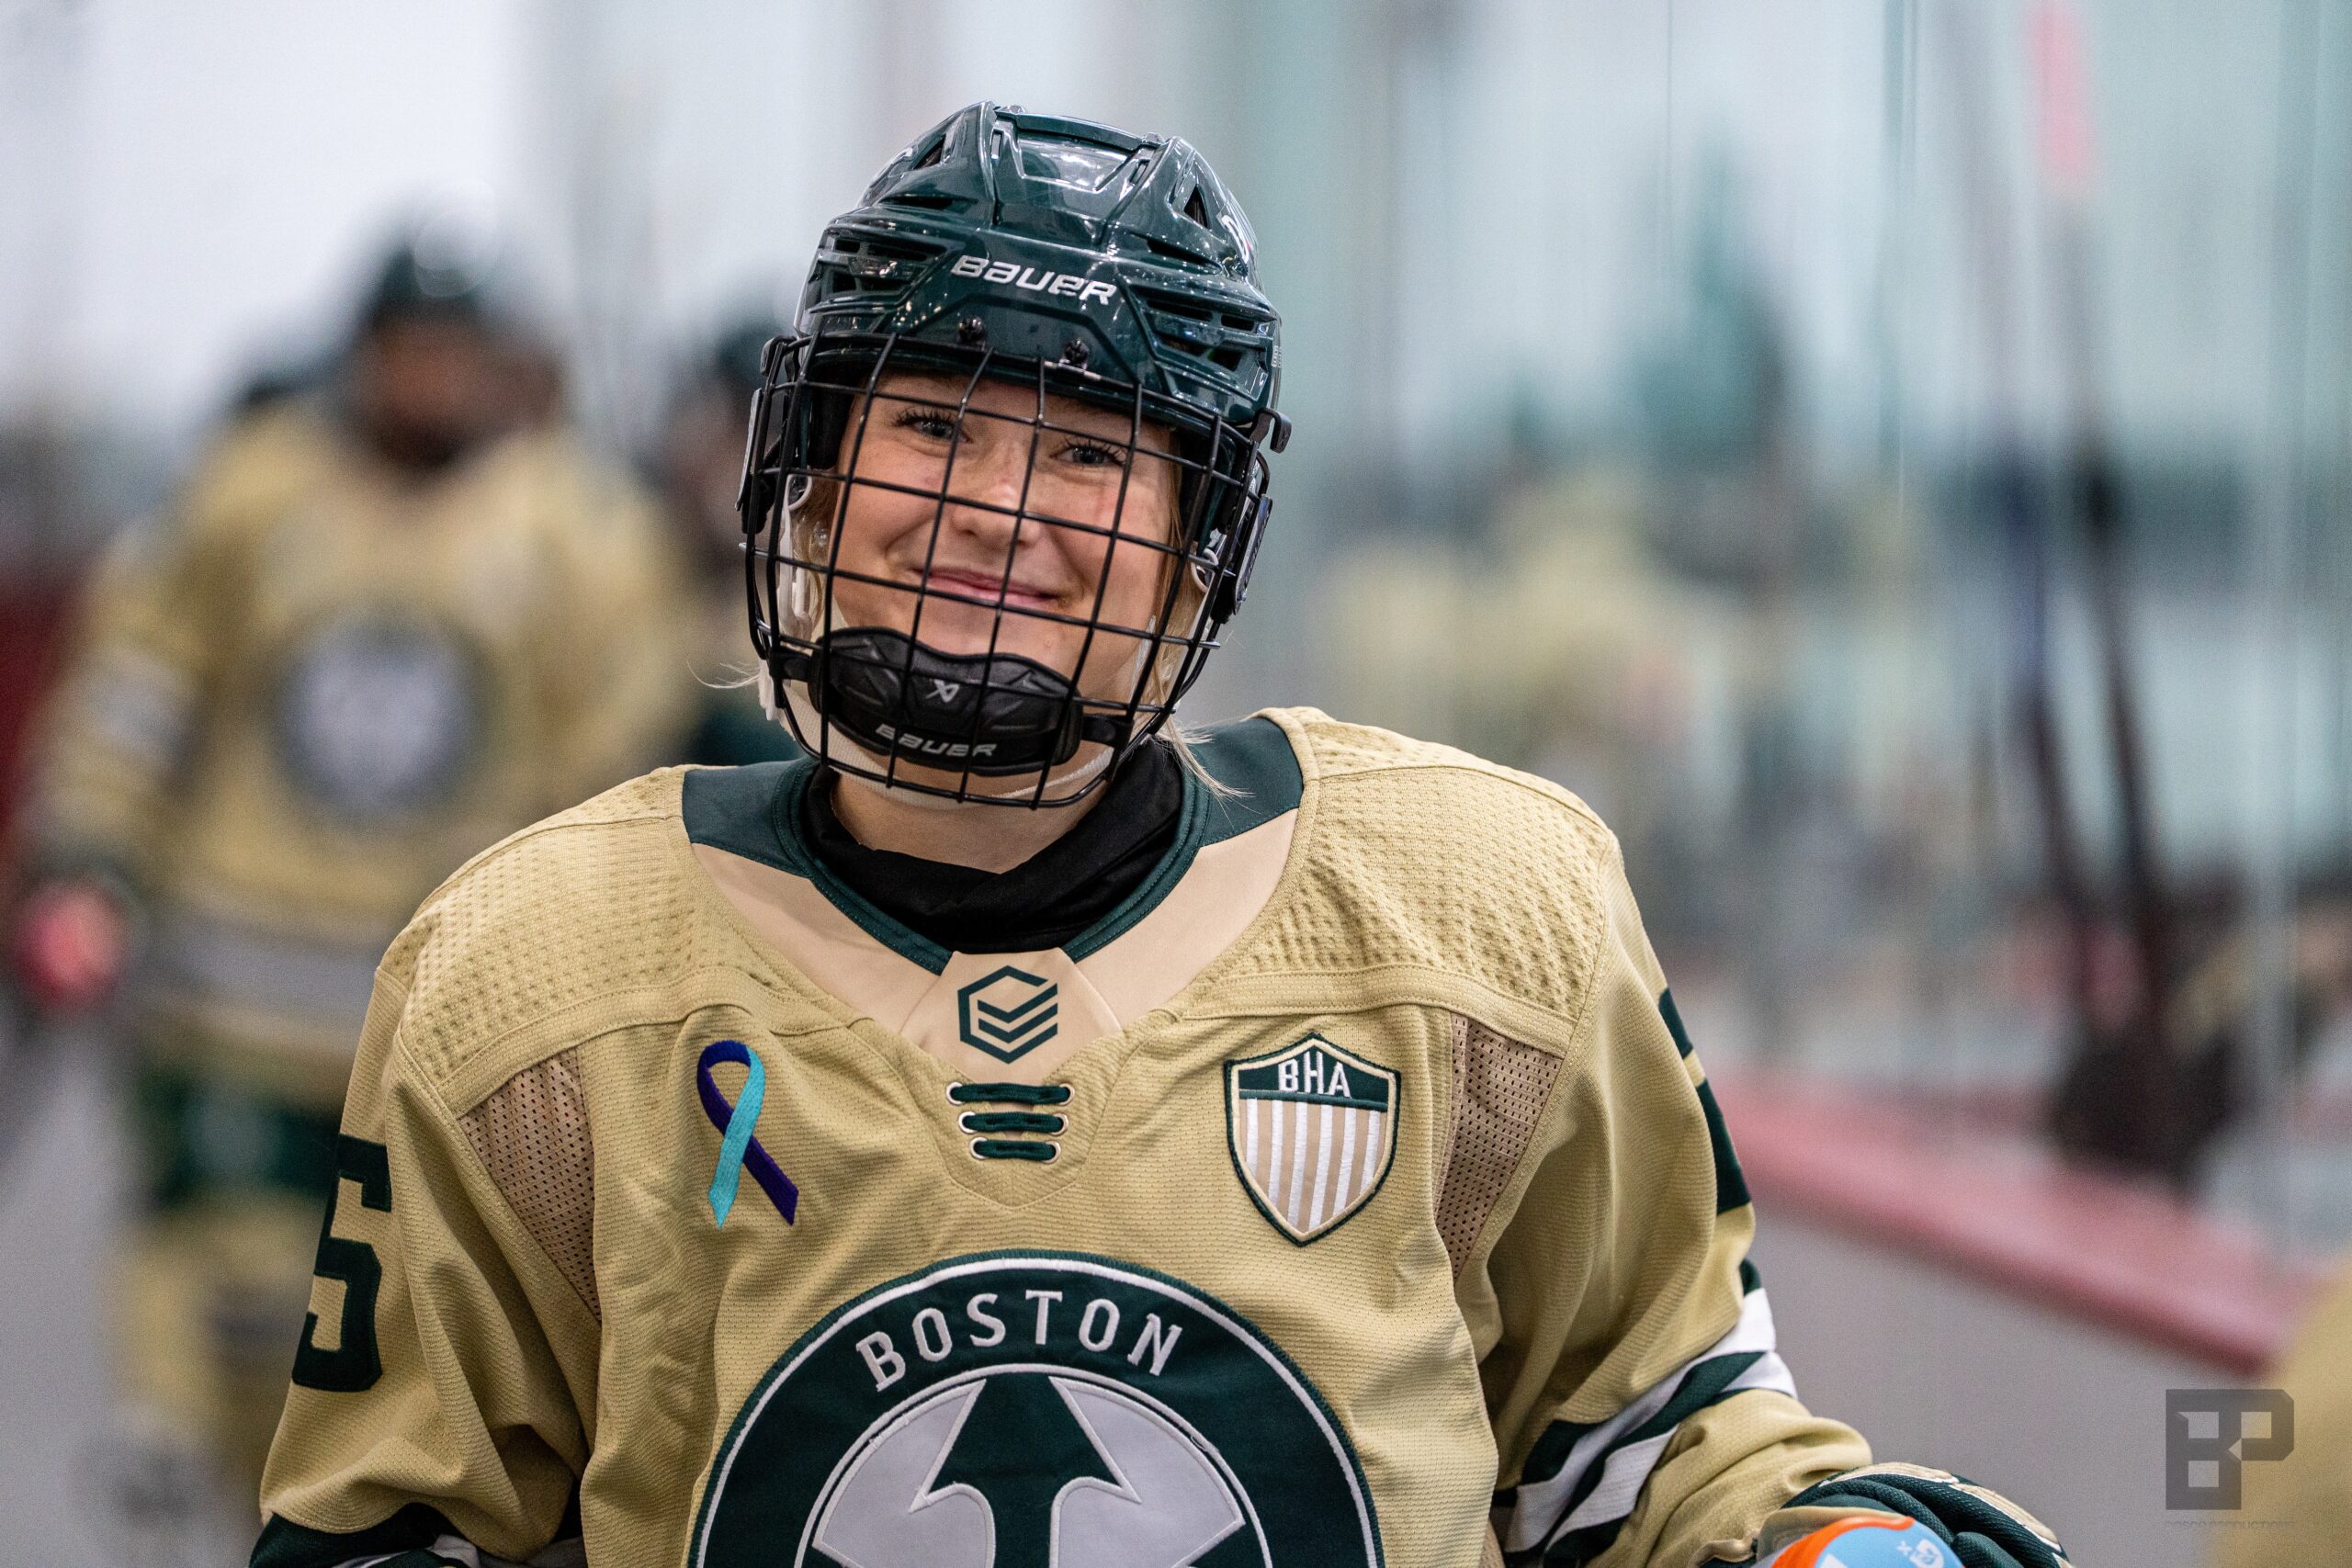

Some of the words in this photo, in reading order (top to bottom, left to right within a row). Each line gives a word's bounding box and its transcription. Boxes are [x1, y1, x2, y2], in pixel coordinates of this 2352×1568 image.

[950, 254, 1117, 305] BAUER
[1278, 1050, 1351, 1099] BHA
[855, 1290, 1182, 1392] BOSTON
